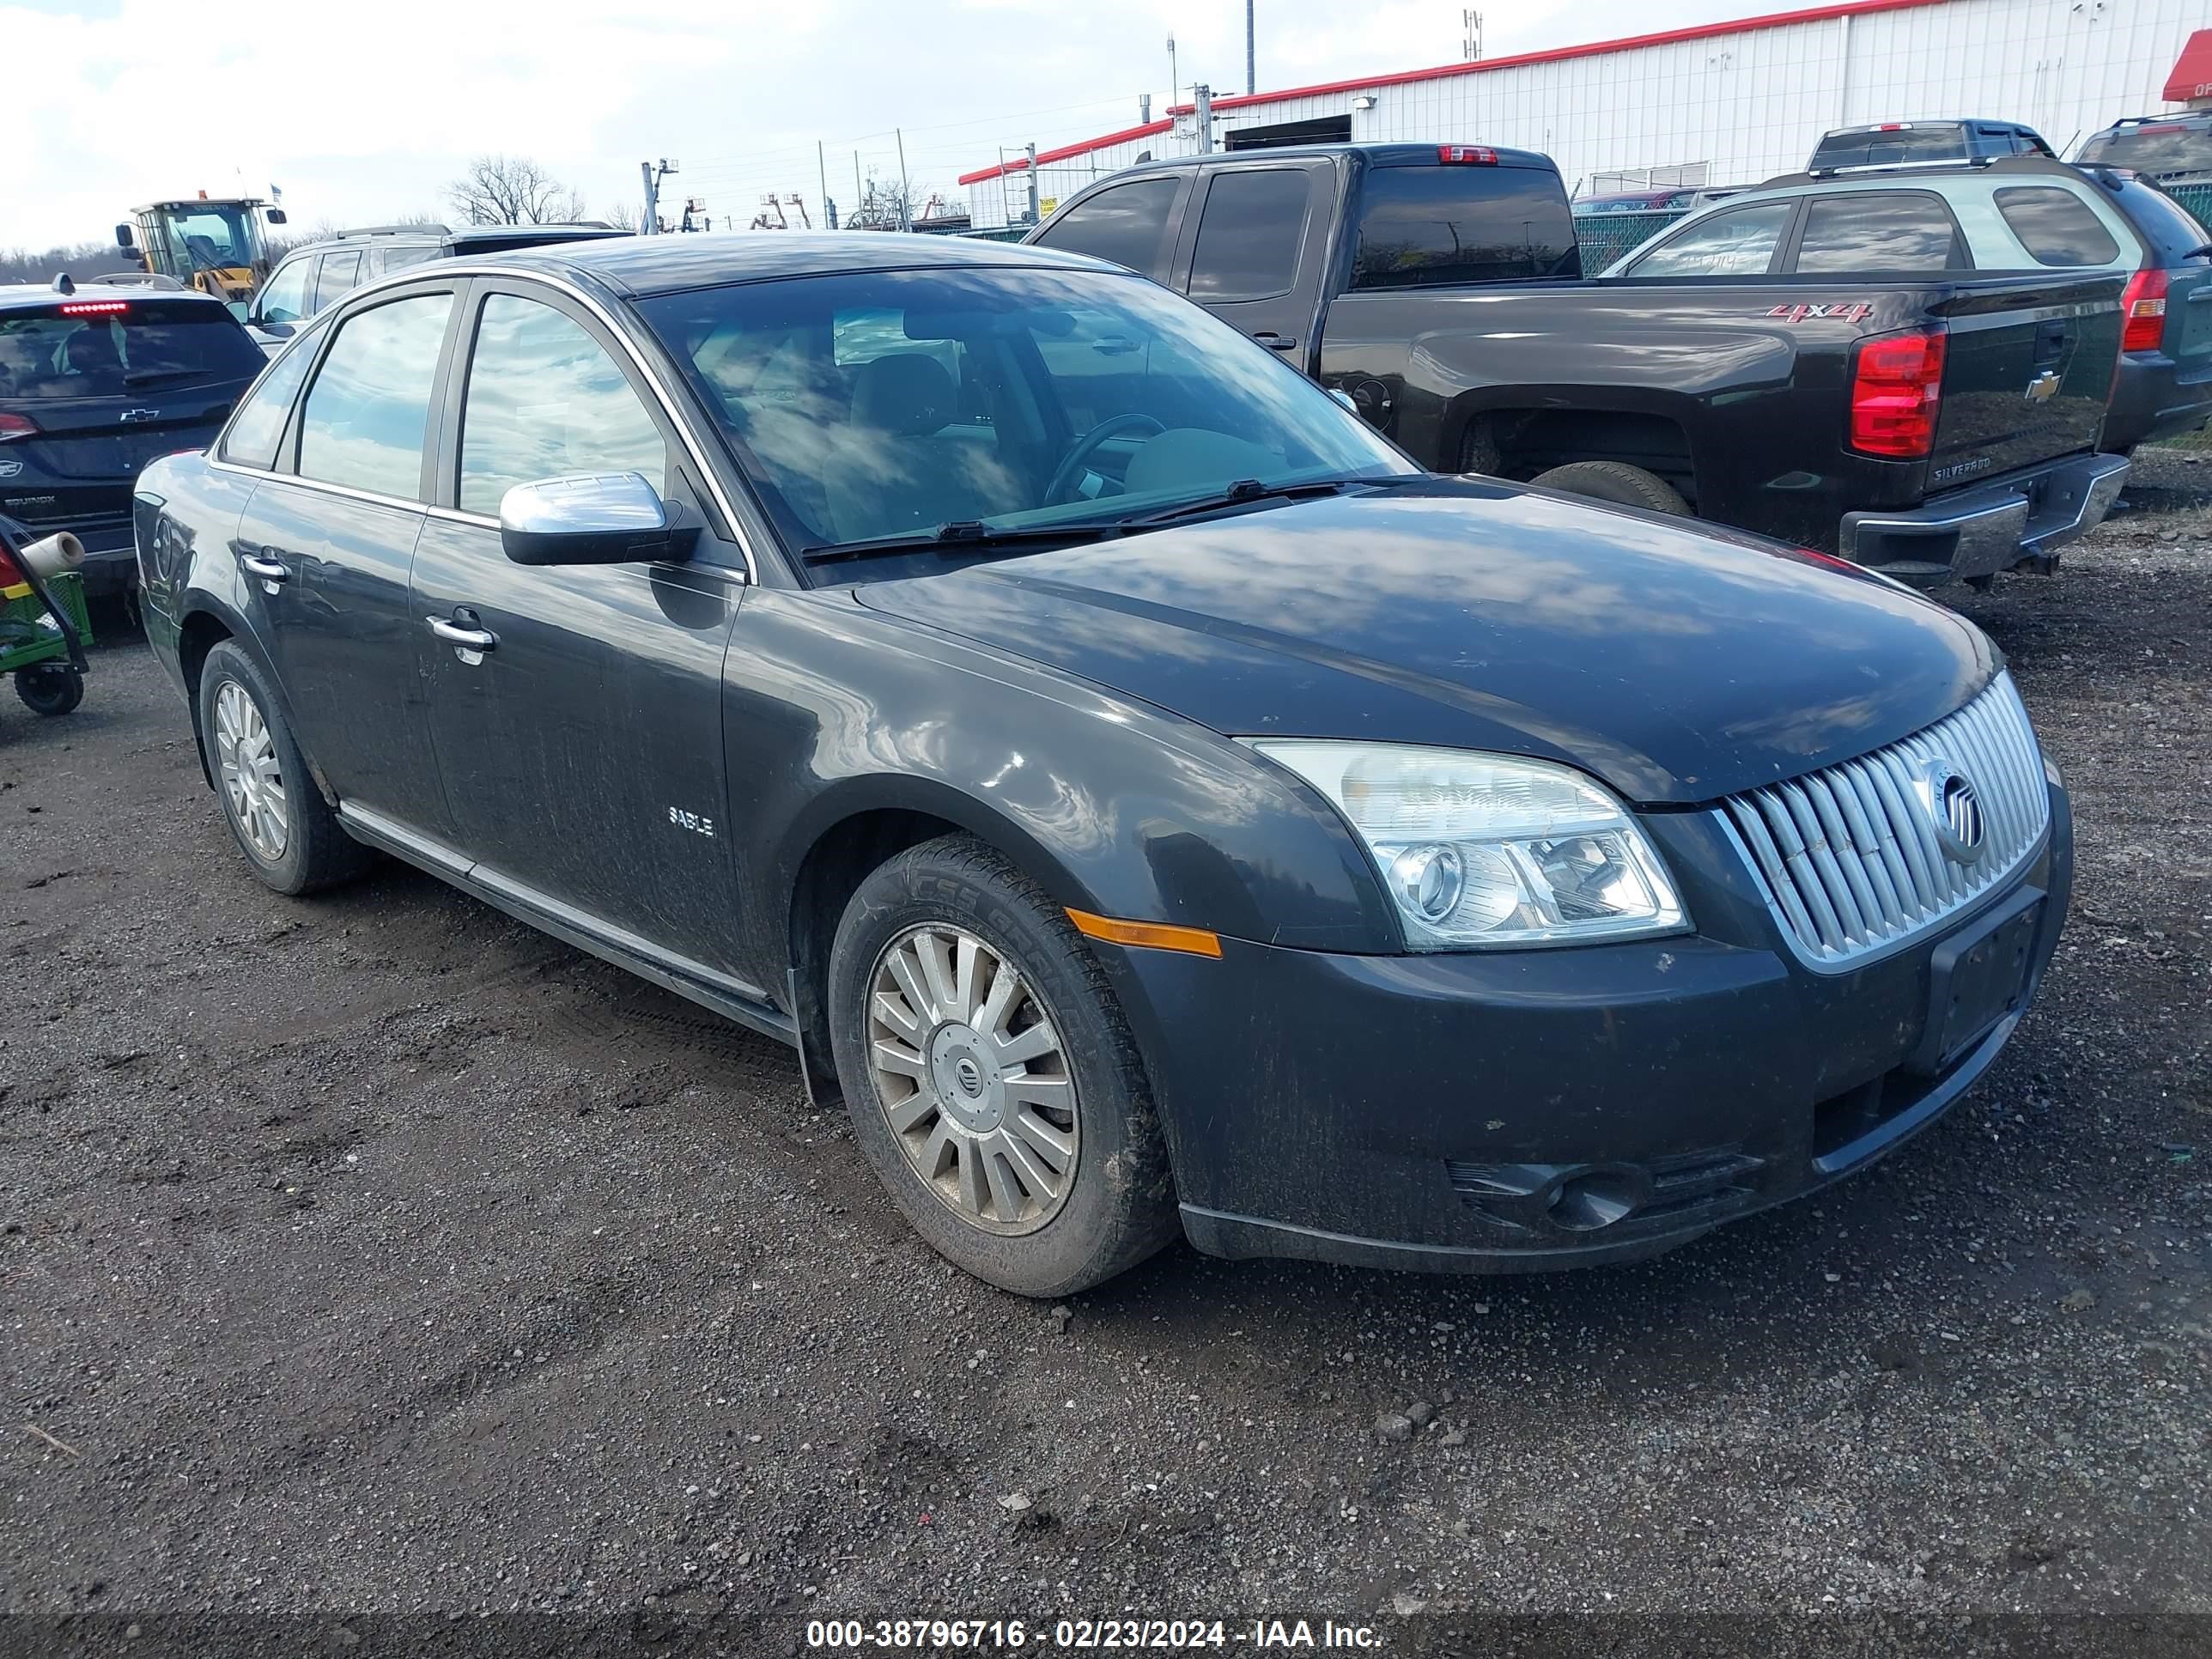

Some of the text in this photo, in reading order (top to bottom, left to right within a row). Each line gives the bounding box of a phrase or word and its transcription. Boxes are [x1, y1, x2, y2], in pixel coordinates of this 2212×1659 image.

[1934, 458, 1991, 481] SILVERADO
[4, 495, 55, 506] EQUINOX
[669, 805, 714, 836] SABLE
